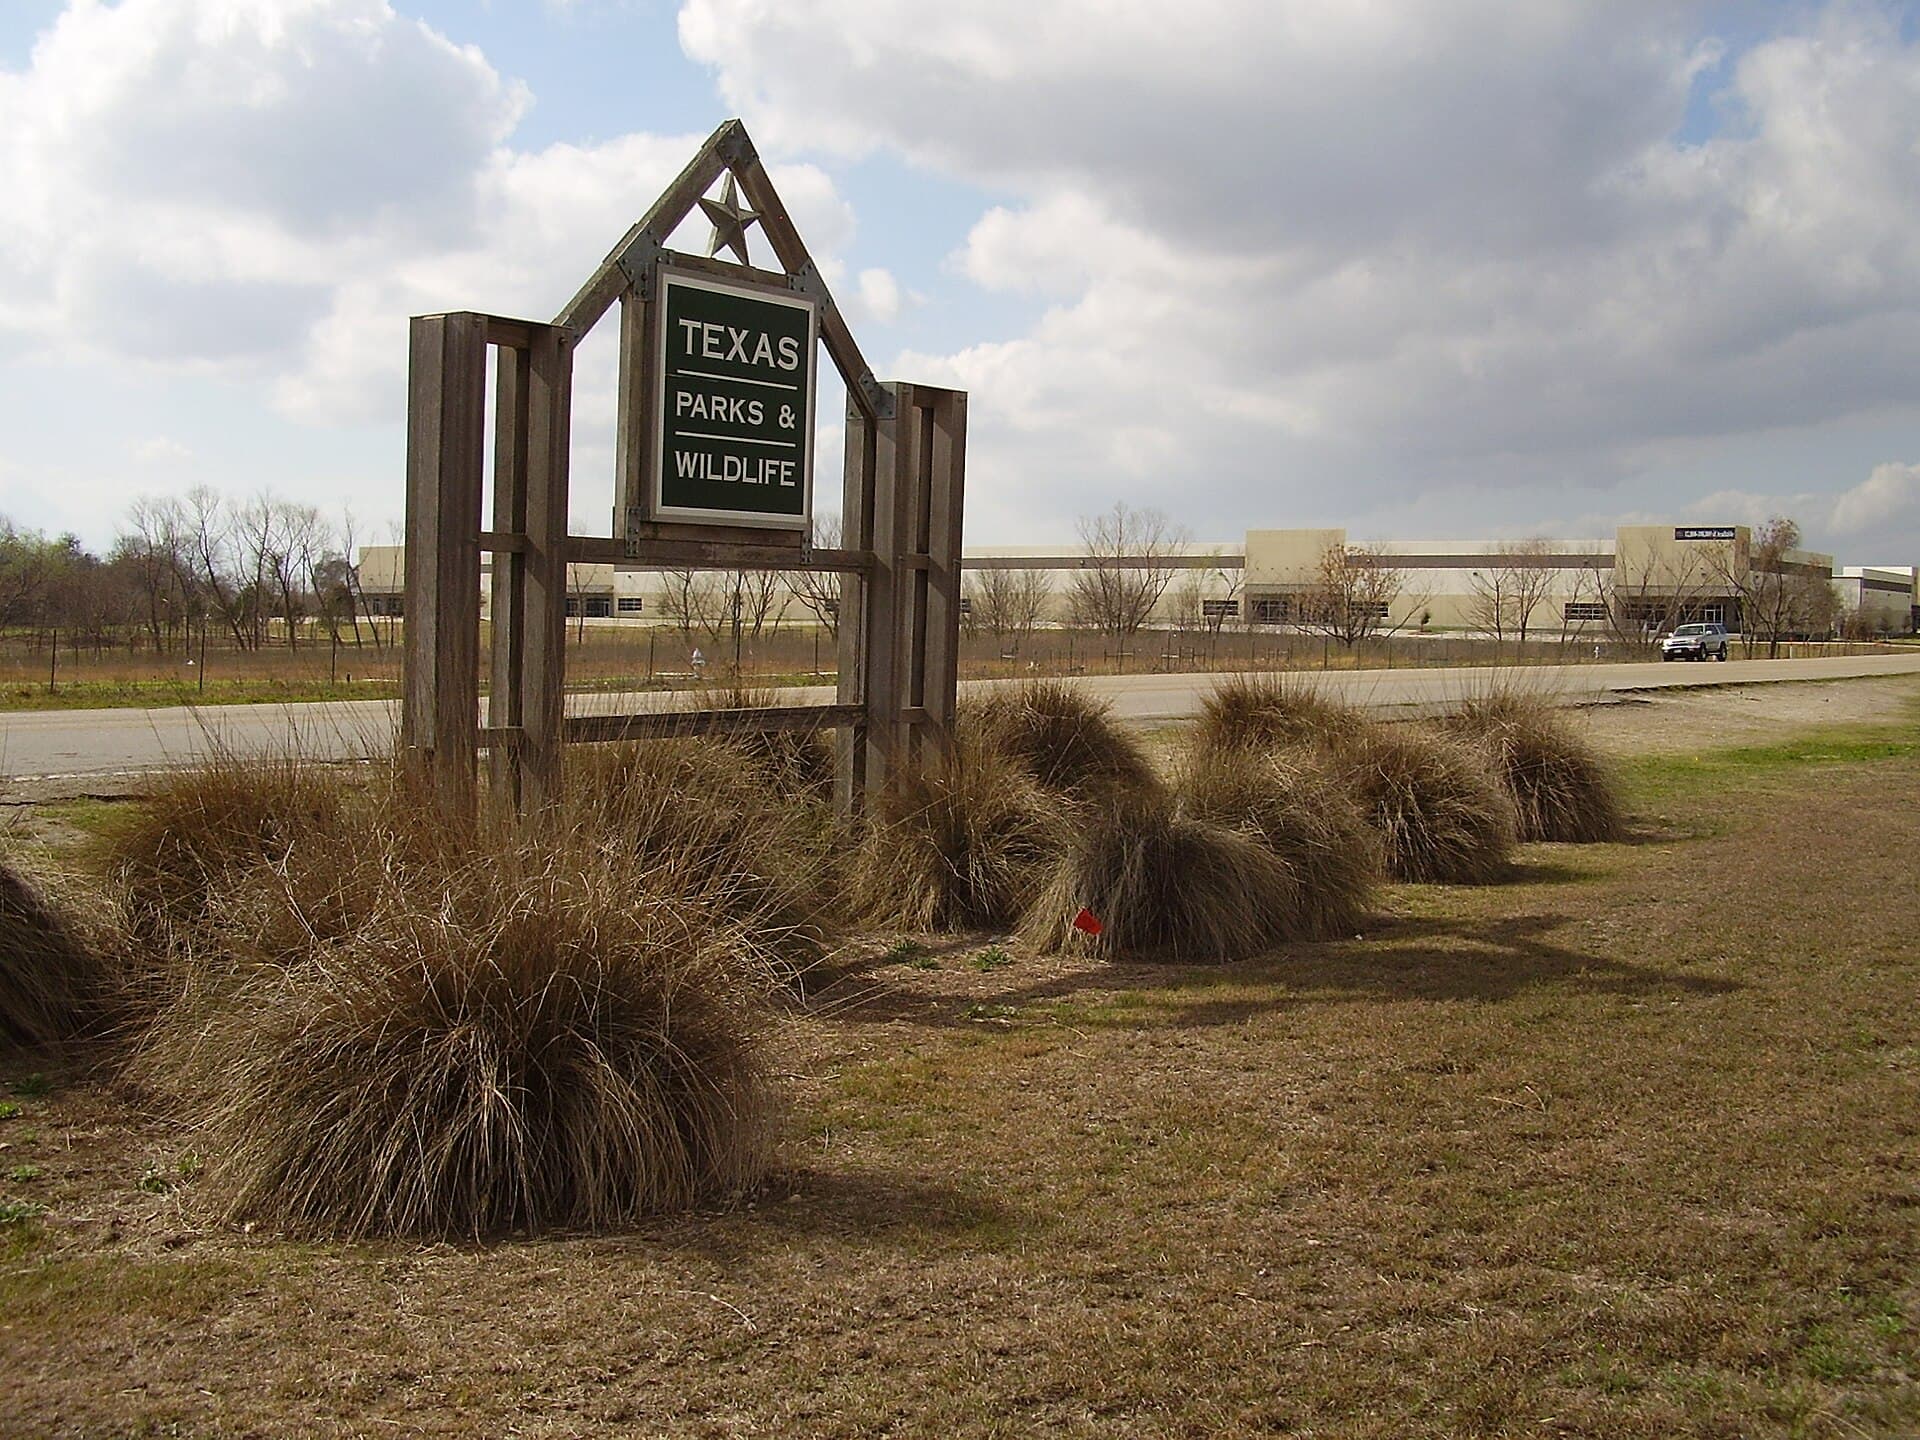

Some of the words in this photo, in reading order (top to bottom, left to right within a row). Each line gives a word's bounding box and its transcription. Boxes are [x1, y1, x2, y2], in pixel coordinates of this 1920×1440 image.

[679, 319, 799, 370] TEXAS
[676, 392, 764, 425] PARKS
[779, 405, 795, 429] &
[675, 451, 795, 486] WILDLIFE
